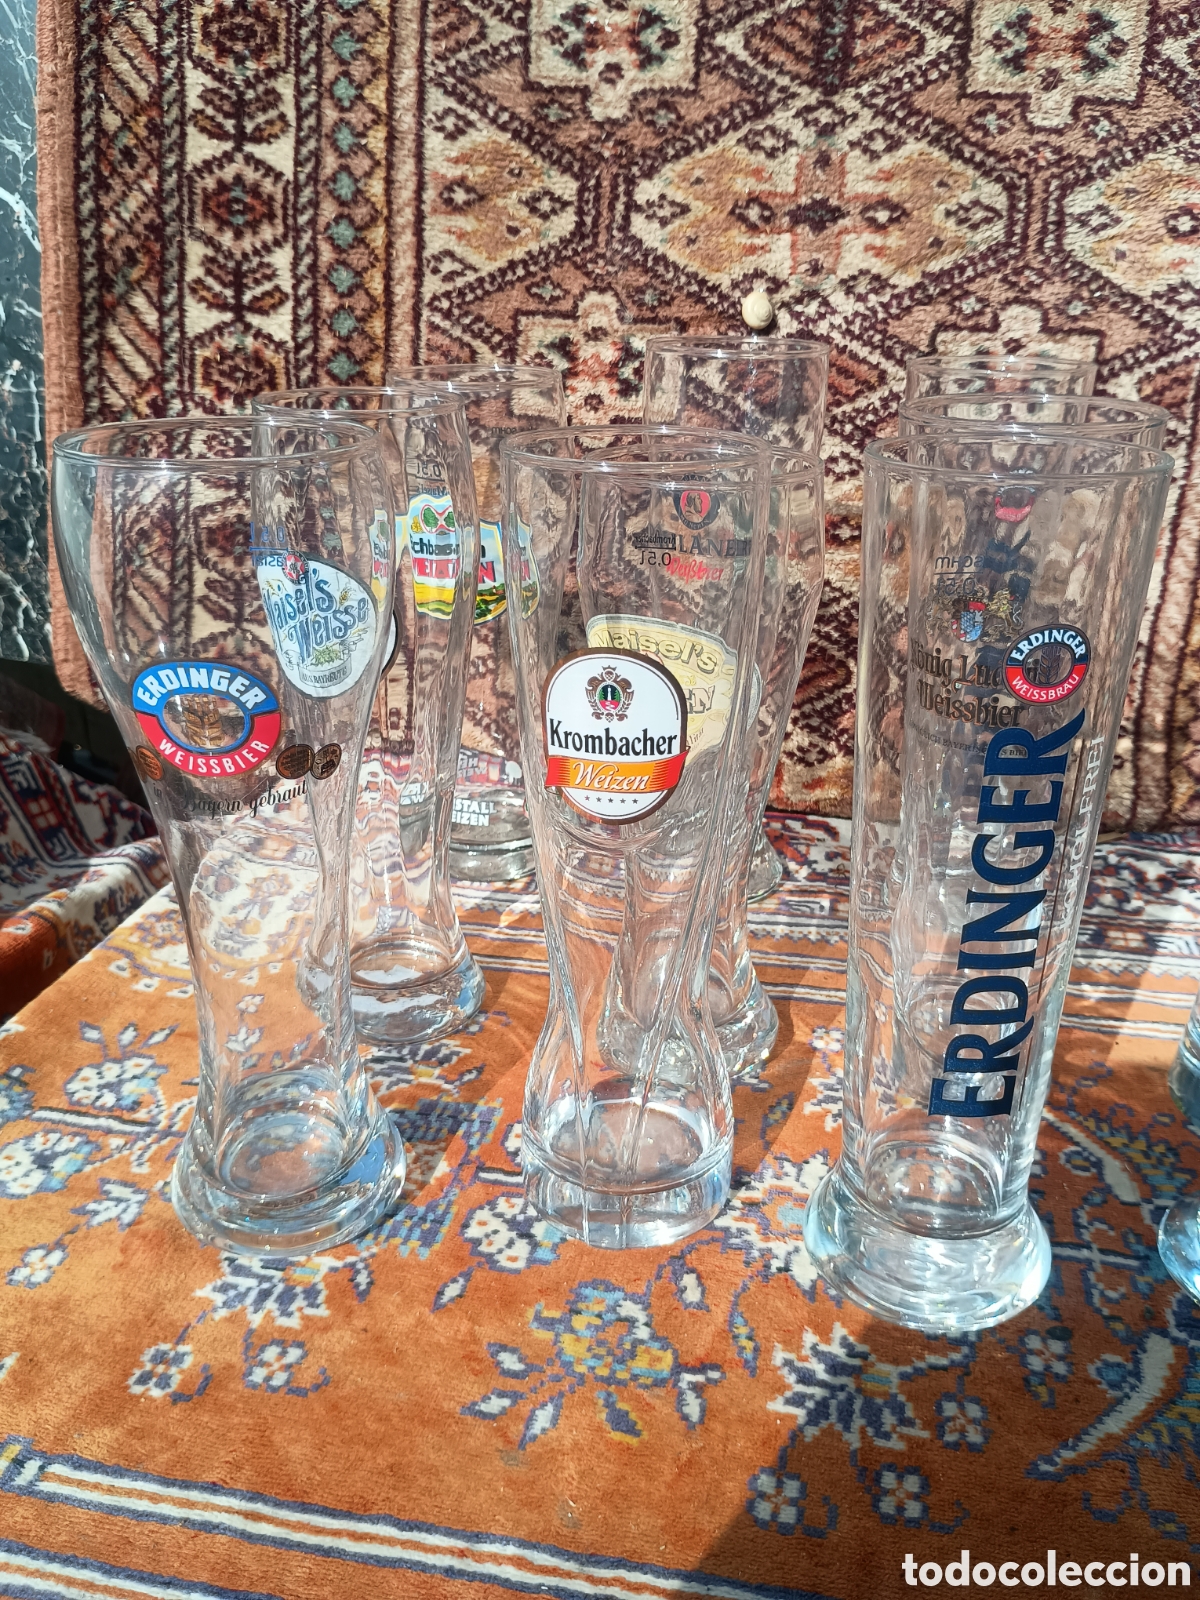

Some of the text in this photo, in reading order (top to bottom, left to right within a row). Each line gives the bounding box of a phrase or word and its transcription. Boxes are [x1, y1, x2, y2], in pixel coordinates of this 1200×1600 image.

[679, 533, 752, 558] LANER
[594, 628, 718, 675] Maisel's
[1009, 629, 1086, 661] ERDINGER
[136, 667, 267, 710] ERDINGER
[1011, 673, 1080, 701] WEISSBRÄU
[159, 738, 270, 775] WEISSBIER
[549, 718, 678, 757] Krombacher
[572, 761, 651, 791] Weizen
[248, 779, 308, 819] gebraut
[927, 706, 1086, 1118] ERDINGER
